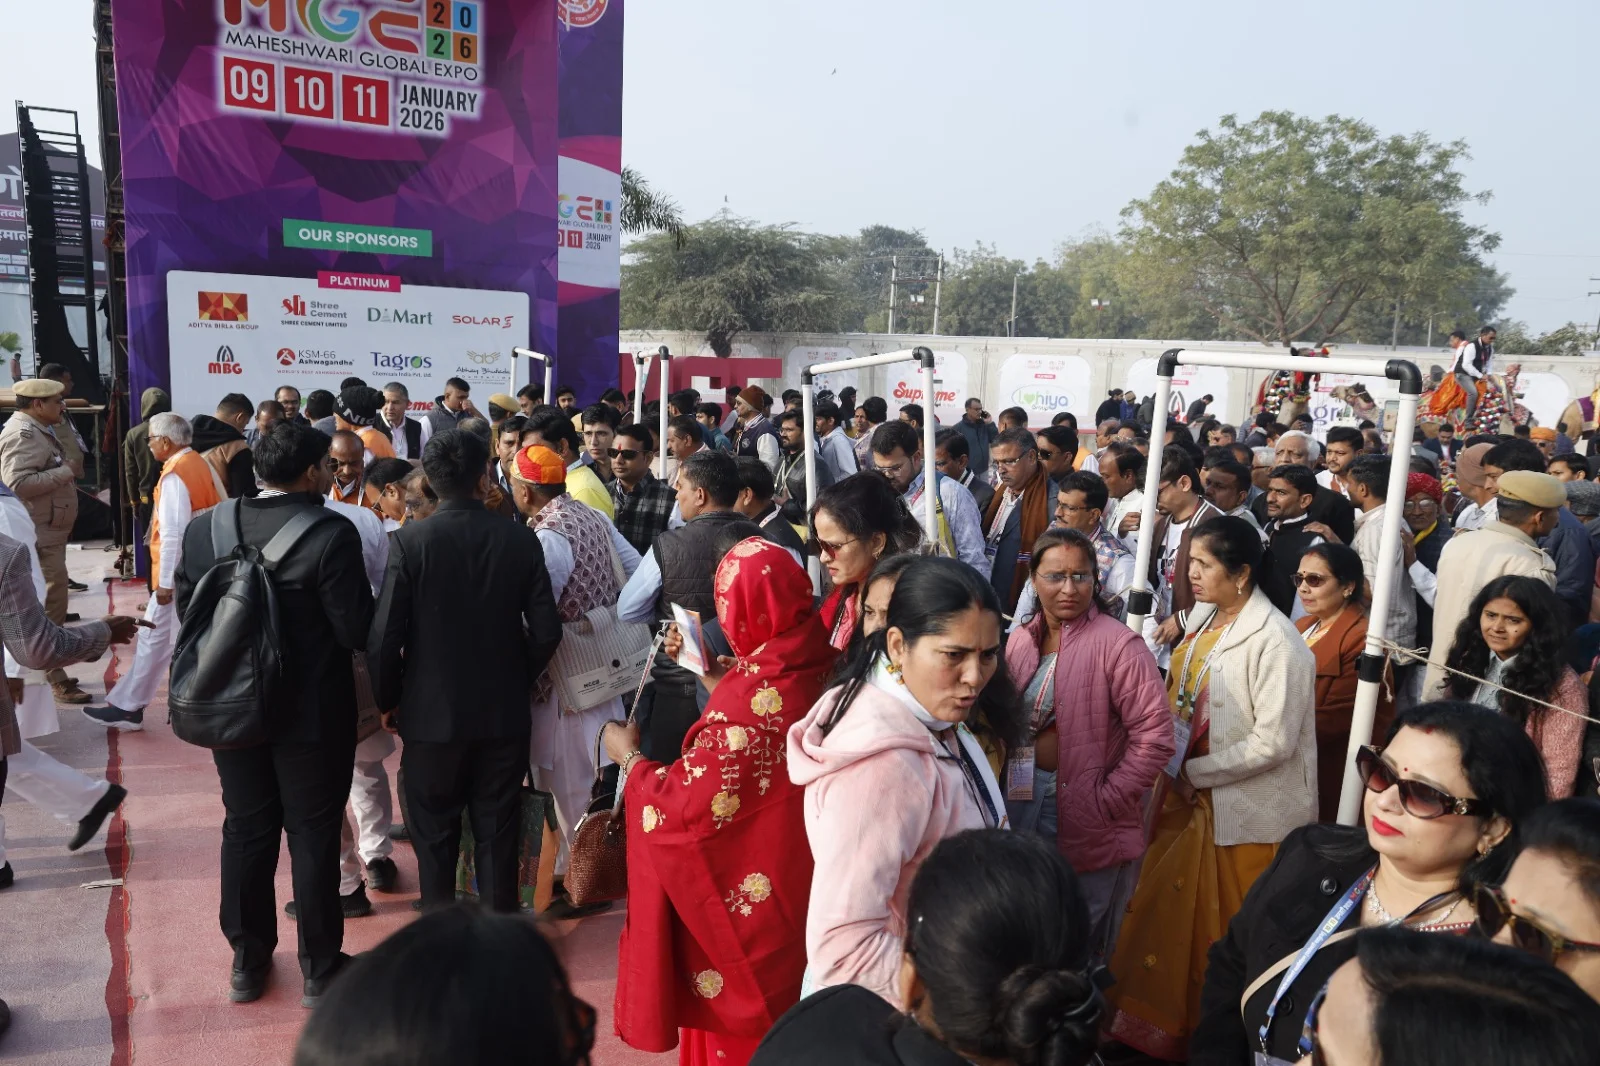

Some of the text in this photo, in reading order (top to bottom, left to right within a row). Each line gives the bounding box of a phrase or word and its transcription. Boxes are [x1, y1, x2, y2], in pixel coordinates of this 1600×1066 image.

[225, 30, 478, 81] MAHESHWARI GLOBAL EXPO
[230, 65, 377, 118] 09 10 11
[400, 84, 478, 112] JANUARY
[400, 107, 445, 131] 2026
[299, 228, 418, 248] OUR SPONSORS
[570, 233, 579, 246] 11
[586, 232, 612, 242] JANUARY
[586, 241, 601, 250] 2026
[330, 276, 390, 288] PLATINUM
[310, 301, 339, 310] Shree
[310, 310, 348, 318] Cement
[452, 316, 500, 326] SOLAR
[298, 350, 336, 360] KSM-66
[370, 352, 432, 370] Tagros
[208, 362, 242, 374] MBG
